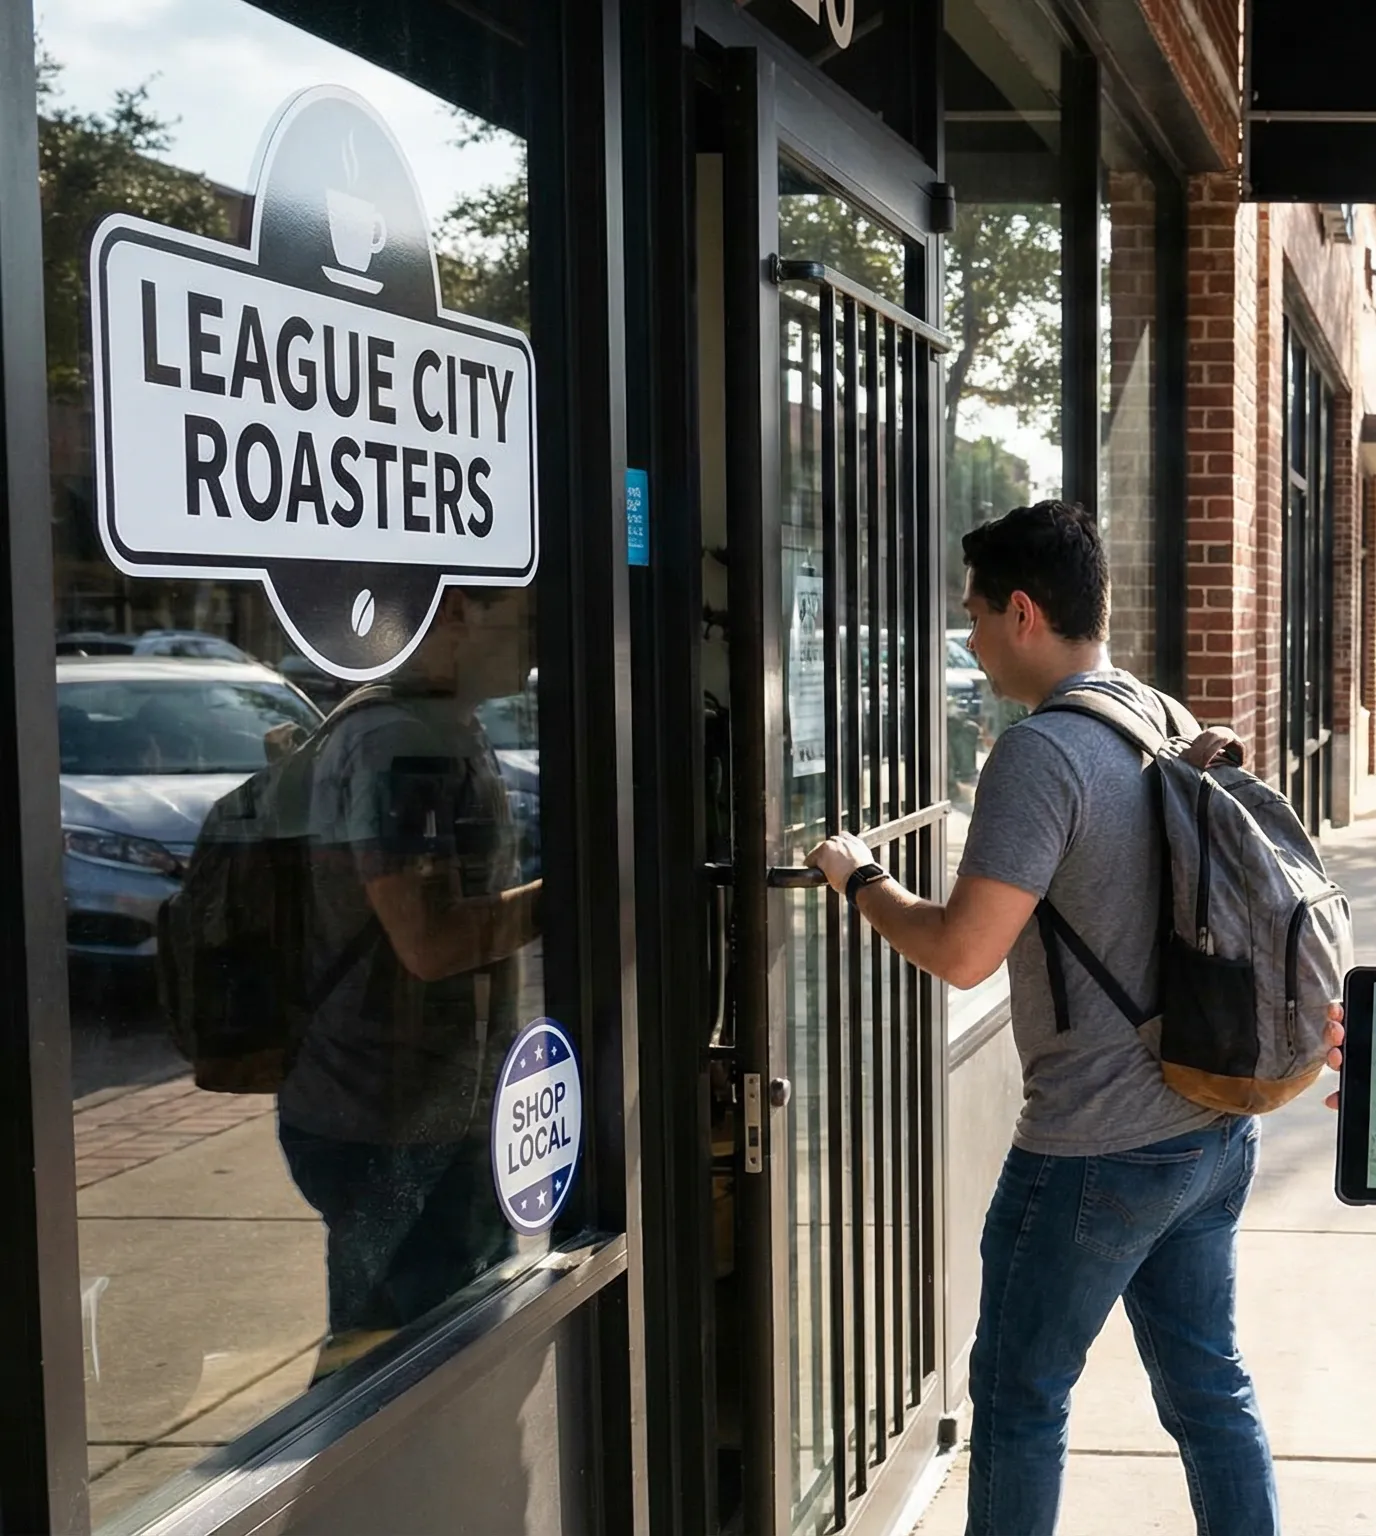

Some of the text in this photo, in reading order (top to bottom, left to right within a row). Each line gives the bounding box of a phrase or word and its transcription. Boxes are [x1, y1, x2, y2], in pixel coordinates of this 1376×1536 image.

[140, 279, 514, 443] LEAGUE CITY
[184, 413, 495, 538] ROASTERS
[508, 1117, 571, 1174] LOCAL
[512, 1081, 566, 1133] SHOP
